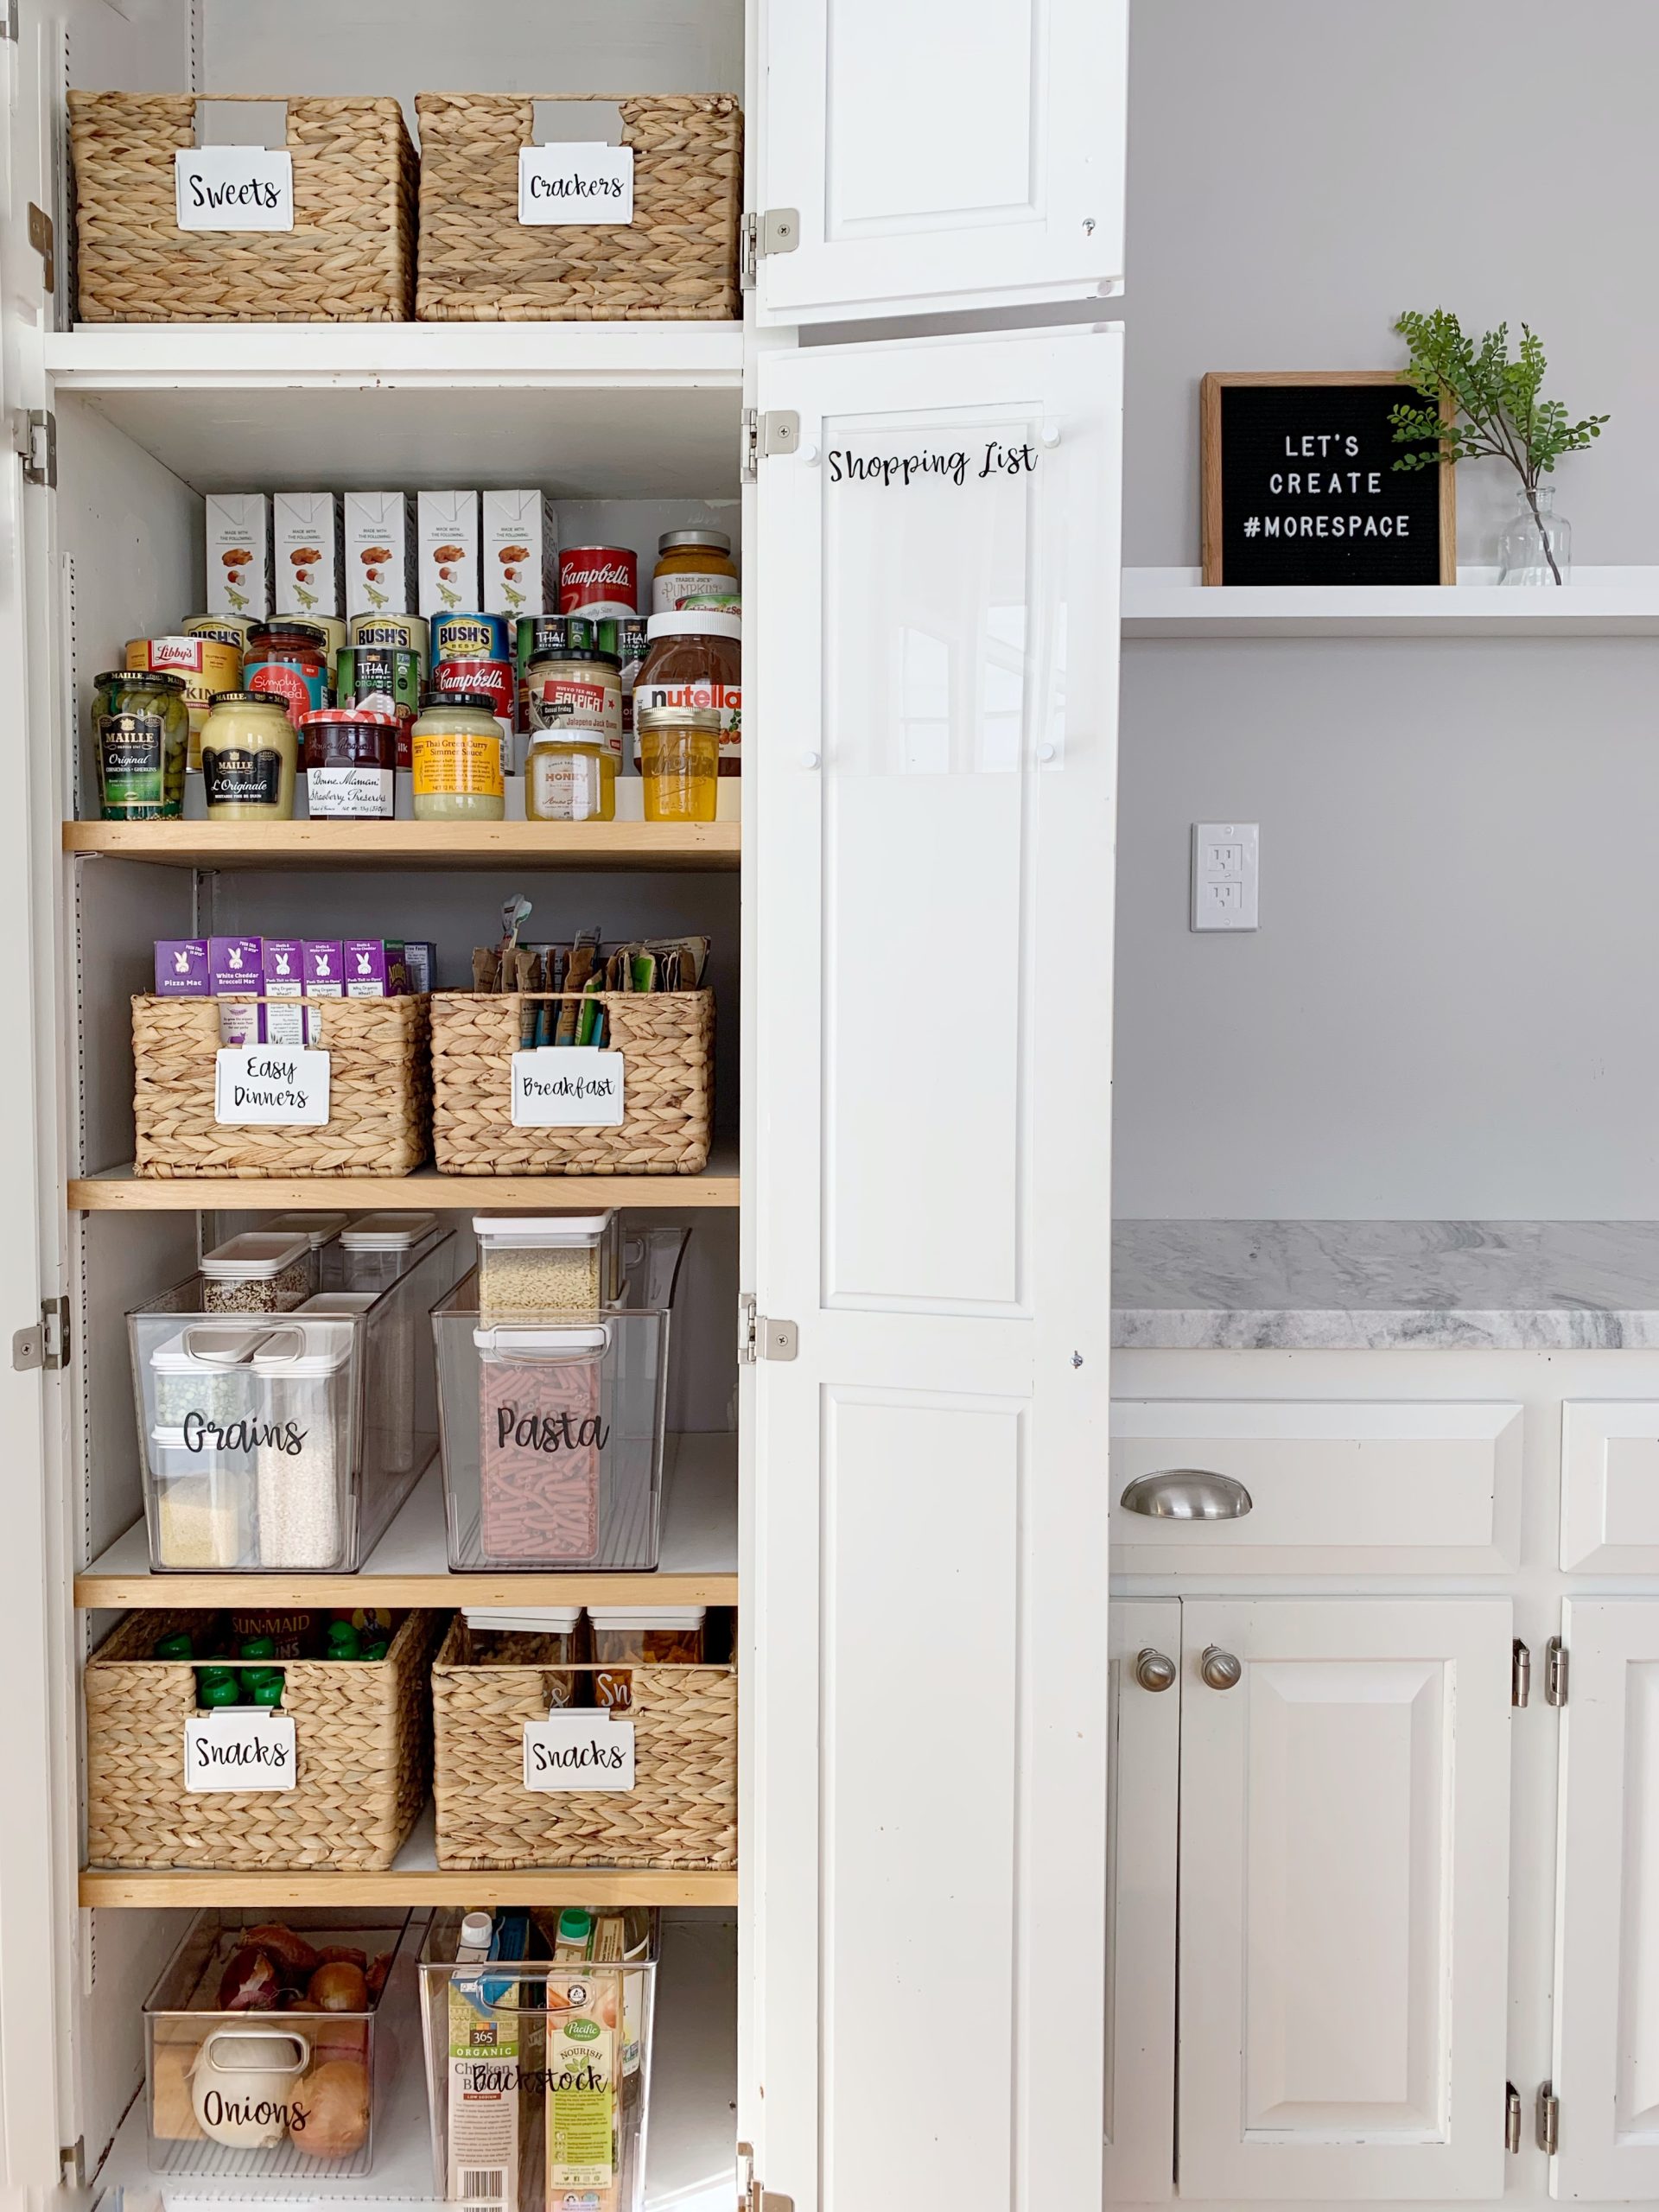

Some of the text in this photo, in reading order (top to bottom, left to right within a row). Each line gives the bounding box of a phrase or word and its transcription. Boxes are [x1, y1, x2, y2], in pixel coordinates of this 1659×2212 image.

[189, 175, 281, 208] Sweets
[531, 174, 624, 200] Crackers
[1286, 435, 1358, 457] LET'S
[828, 442, 1039, 486] Shopping List
[1270, 473, 1381, 494] CREATE
[1243, 516, 1409, 537] #MORESPACE
[562, 563, 630, 588] Campbell's
[358, 628, 408, 646] BUSH'S
[440, 626, 490, 645] BUSH'S
[536, 631, 564, 643] THAI
[156, 644, 192, 661] Libby's
[254, 673, 300, 692] Simply
[441, 669, 503, 692] Campbell's
[555, 692, 601, 712] SALPICA
[652, 684, 741, 709] nutella
[105, 733, 154, 743] MAILLE
[397, 743, 408, 753] ilk
[426, 740, 441, 748] Thai
[109, 753, 151, 765] Original
[218, 760, 254, 769] MAILLE
[313, 770, 379, 786] Bonne Maman
[247, 1056, 297, 1084] Easy
[234, 1085, 308, 1109] Dinners
[523, 1077, 614, 1098] Breakfast
[183, 1412, 308, 1455] Grains
[498, 1407, 610, 1453] Pasta
[196, 1737, 289, 1767] Snacks
[532, 1740, 626, 1770] Snacks
[474, 2031, 493, 2044] 365
[567, 2022, 597, 2035] Pacific
[456, 2048, 512, 2056] ORGANIC
[560, 2048, 603, 2060] NOURISH
[473, 2064, 609, 2094] Backstock
[204, 2090, 311, 2132] Onions
